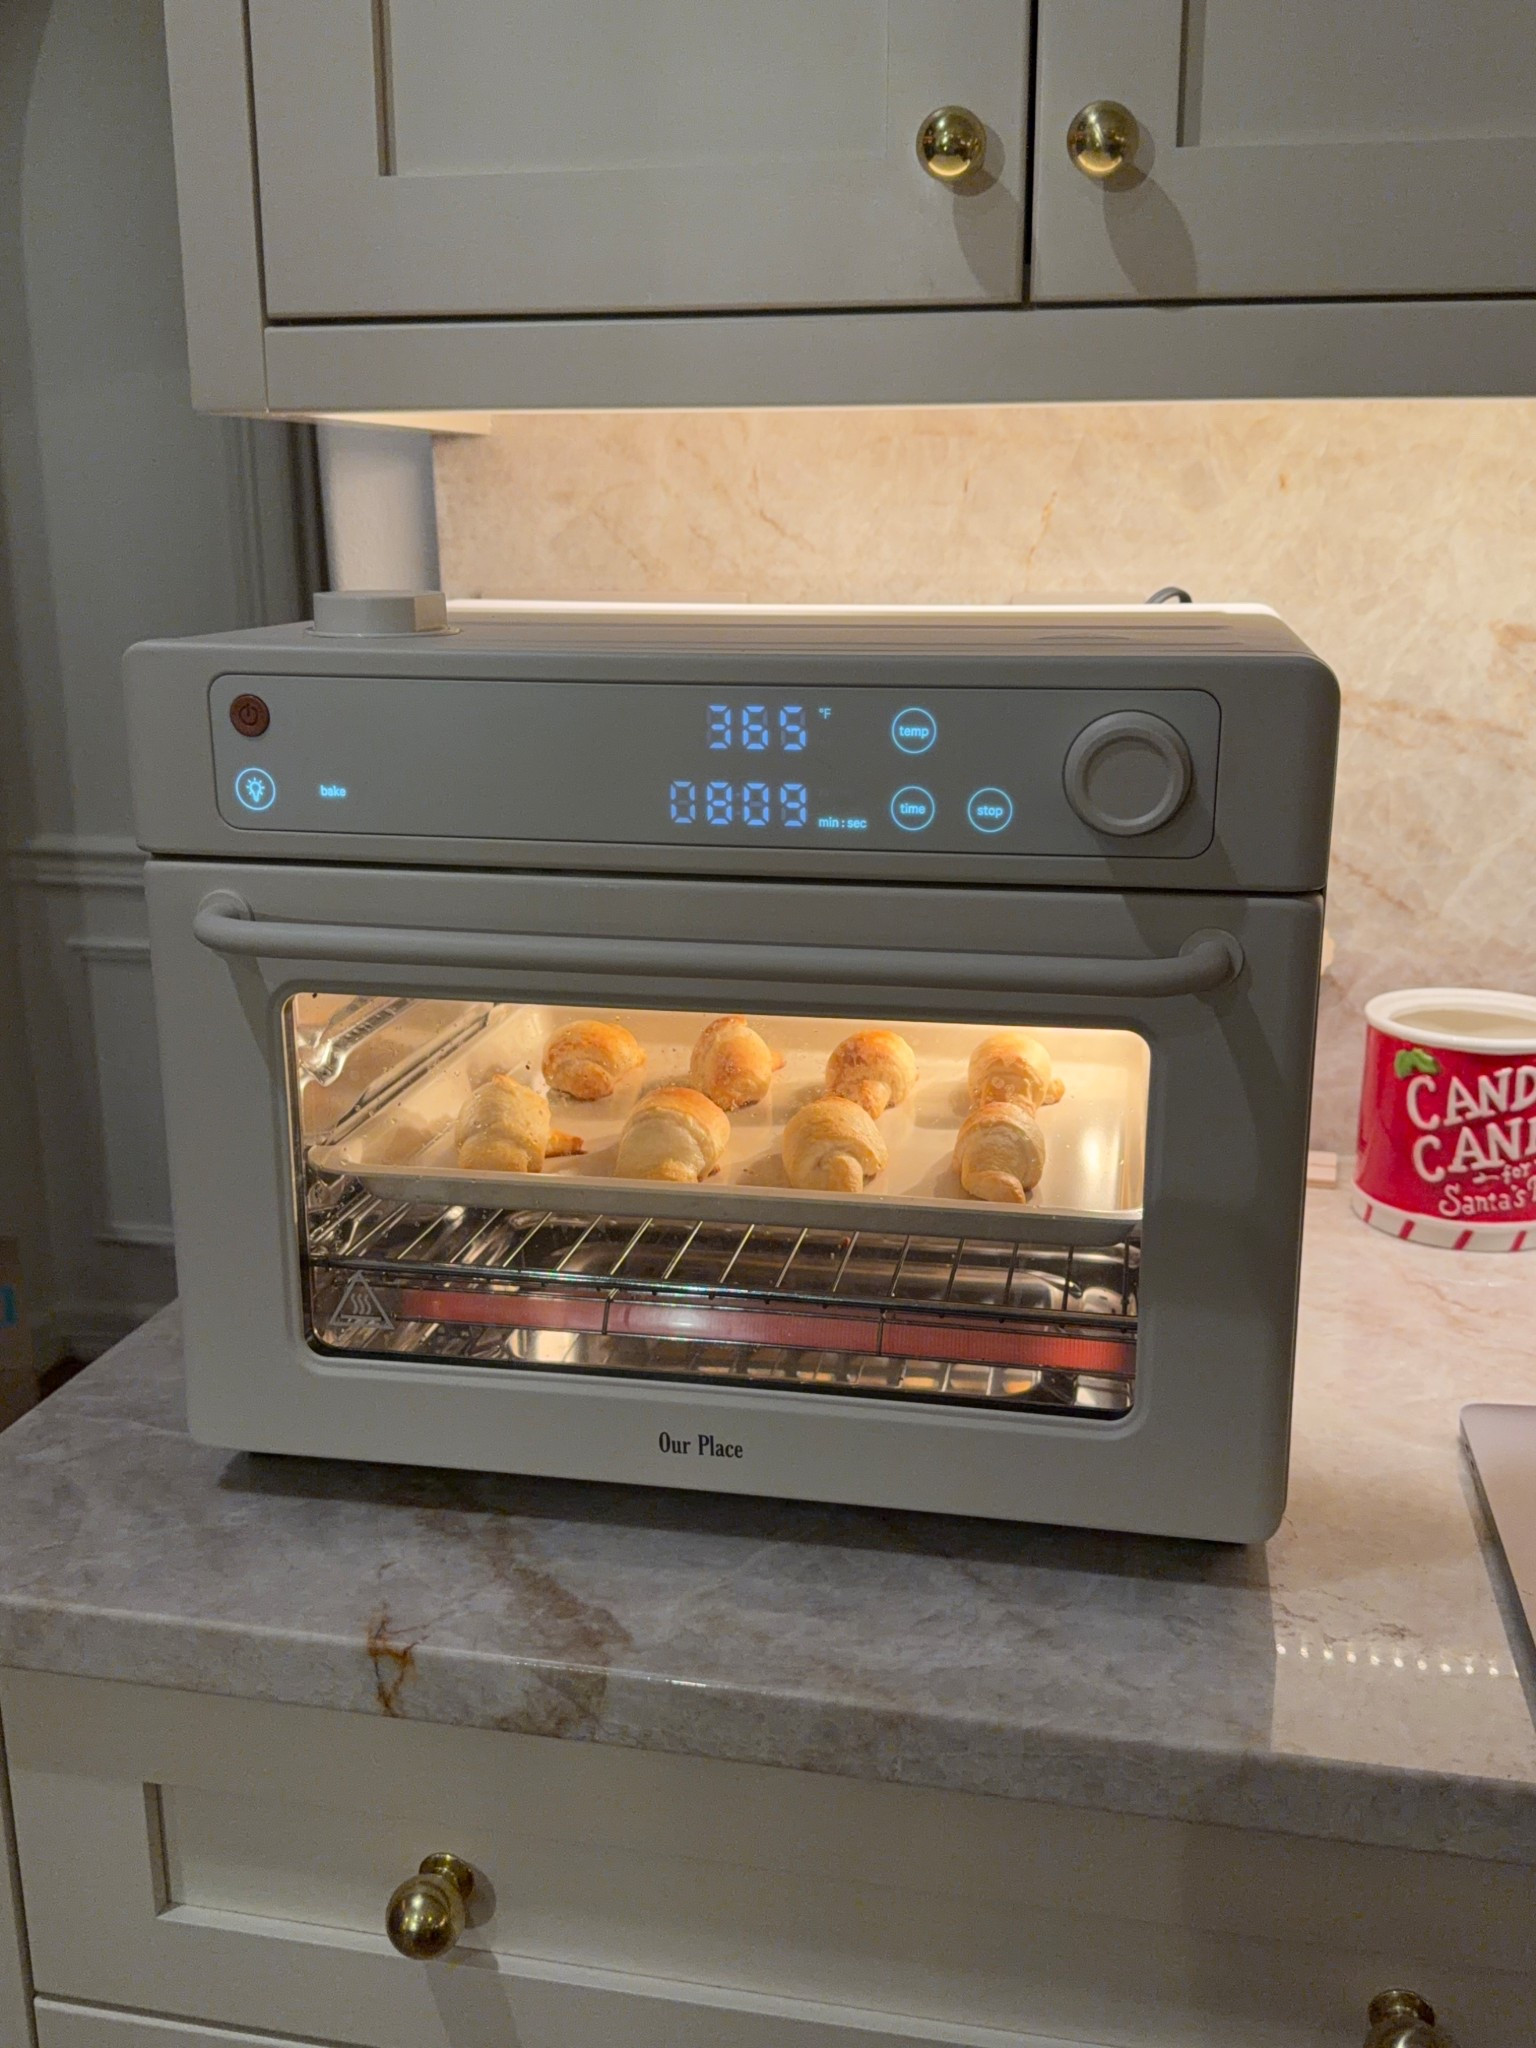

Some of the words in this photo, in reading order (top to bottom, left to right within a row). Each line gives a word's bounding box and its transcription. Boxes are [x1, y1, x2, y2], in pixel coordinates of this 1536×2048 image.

[708, 704, 807, 751] 365
[899, 725, 930, 740] temp
[319, 784, 347, 797] bake
[899, 803, 927, 815] time
[976, 805, 1004, 819] stop
[1502, 1161, 1532, 1185] for
[1438, 1182, 1528, 1217] Santa's
[658, 1431, 692, 1455] Our
[697, 1433, 744, 1459] Place
